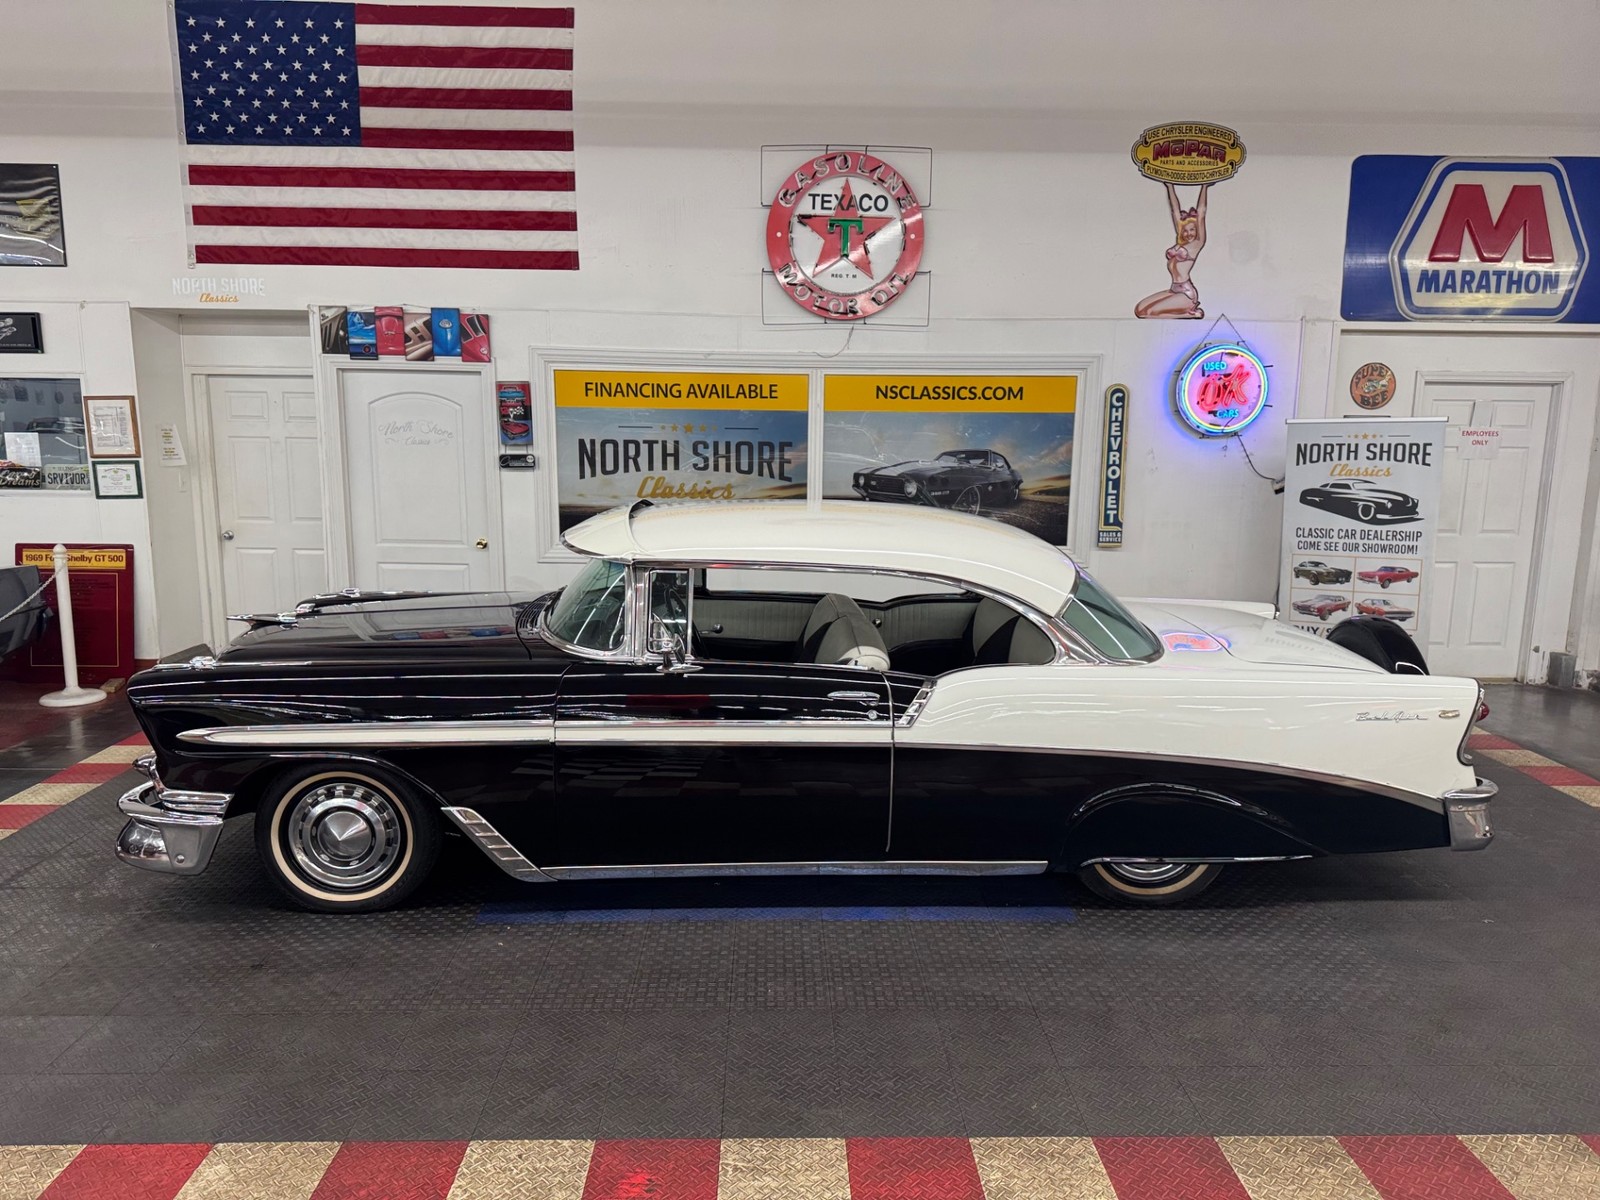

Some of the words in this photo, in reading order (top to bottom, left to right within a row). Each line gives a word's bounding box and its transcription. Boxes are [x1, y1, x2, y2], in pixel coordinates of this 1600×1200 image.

[1147, 130, 1160, 139] USE
[1161, 125, 1194, 136] CHRYSLER
[1194, 126, 1232, 141] ENGINEERED
[778, 153, 917, 213] GASOLINE
[808, 193, 889, 212] TEXACO
[827, 217, 863, 258] T
[171, 277, 217, 296] NORTH
[221, 277, 266, 297] SHORE
[779, 262, 863, 317] MOTOR
[871, 272, 912, 306] OIL
[1416, 269, 1560, 295] MARATHON
[199, 292, 240, 303] Classics
[1203, 361, 1227, 371] USED
[584, 382, 682, 399] FINANCING
[687, 383, 779, 400] AVAILABLE
[876, 384, 1024, 401] NSCLASSICS.COM
[1197, 364, 1251, 412] OK
[1360, 390, 1388, 407] BEE
[1216, 409, 1239, 418] CARS
[378, 421, 413, 436] North
[416, 419, 454, 439] Shore
[577, 437, 680, 480] NORTH
[691, 439, 794, 483] SHORE
[1107, 393, 1123, 523] CHEVROLET
[1295, 442, 1359, 467] NORTH
[1366, 442, 1433, 467] SHORE
[1329, 463, 1393, 478] Classics
[636, 475, 737, 500] Classics
[1295, 527, 1335, 540] CLASSIC
[1337, 528, 1357, 541] CAR
[1359, 529, 1423, 543] DEALERSHIP
[1297, 540, 1322, 552] COME
[1323, 541, 1340, 552] SEE
[1342, 541, 1360, 553] OUR
[1361, 542, 1418, 555] SHOWROOM!
[25, 554, 43, 562] 1969
[94, 554, 107, 562] GT
[108, 554, 124, 562] 500
